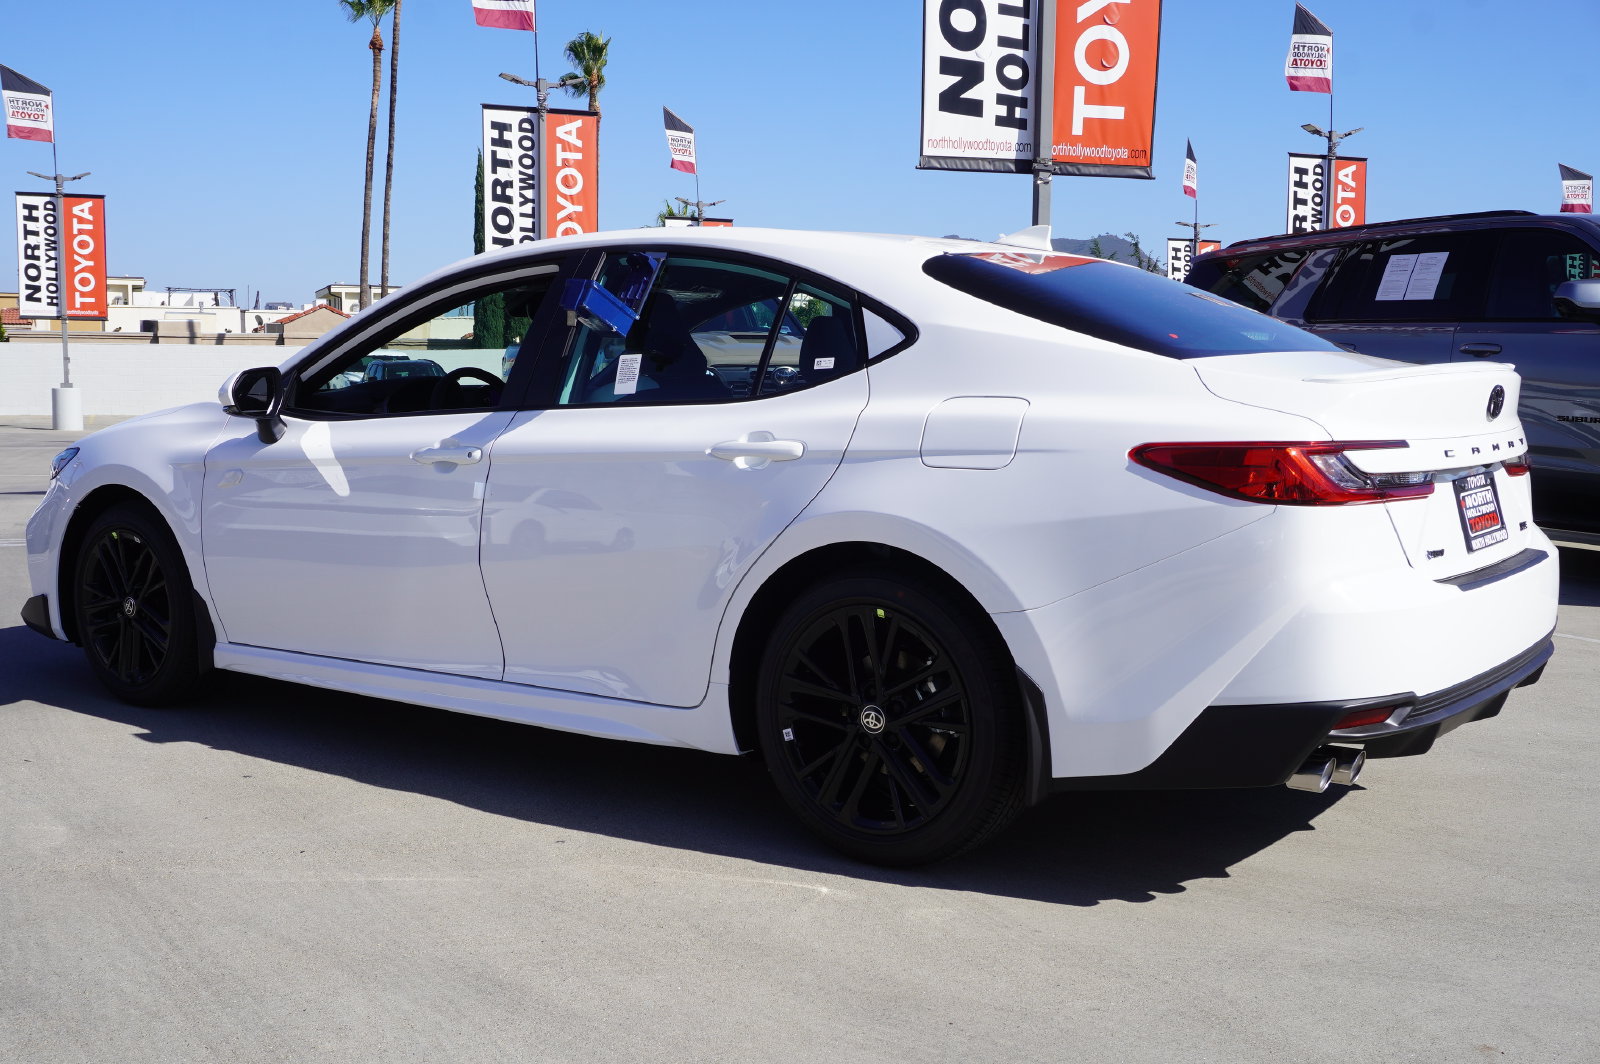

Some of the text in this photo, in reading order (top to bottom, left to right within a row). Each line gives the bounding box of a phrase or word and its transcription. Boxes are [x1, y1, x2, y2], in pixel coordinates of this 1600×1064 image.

[927, 136, 1032, 154] northhollywoodtoyota.com
[22, 202, 42, 303] NORTH
[43, 199, 59, 307] HOLLYWOOD
[72, 200, 96, 308] TOYOTA
[1443, 438, 1524, 458] CAMRY
[1466, 474, 1486, 489] TOYOTA
[1464, 489, 1493, 509] NORTH
[1466, 502, 1496, 519] HOLLYWOOD
[1468, 512, 1500, 533] TOYOTA
